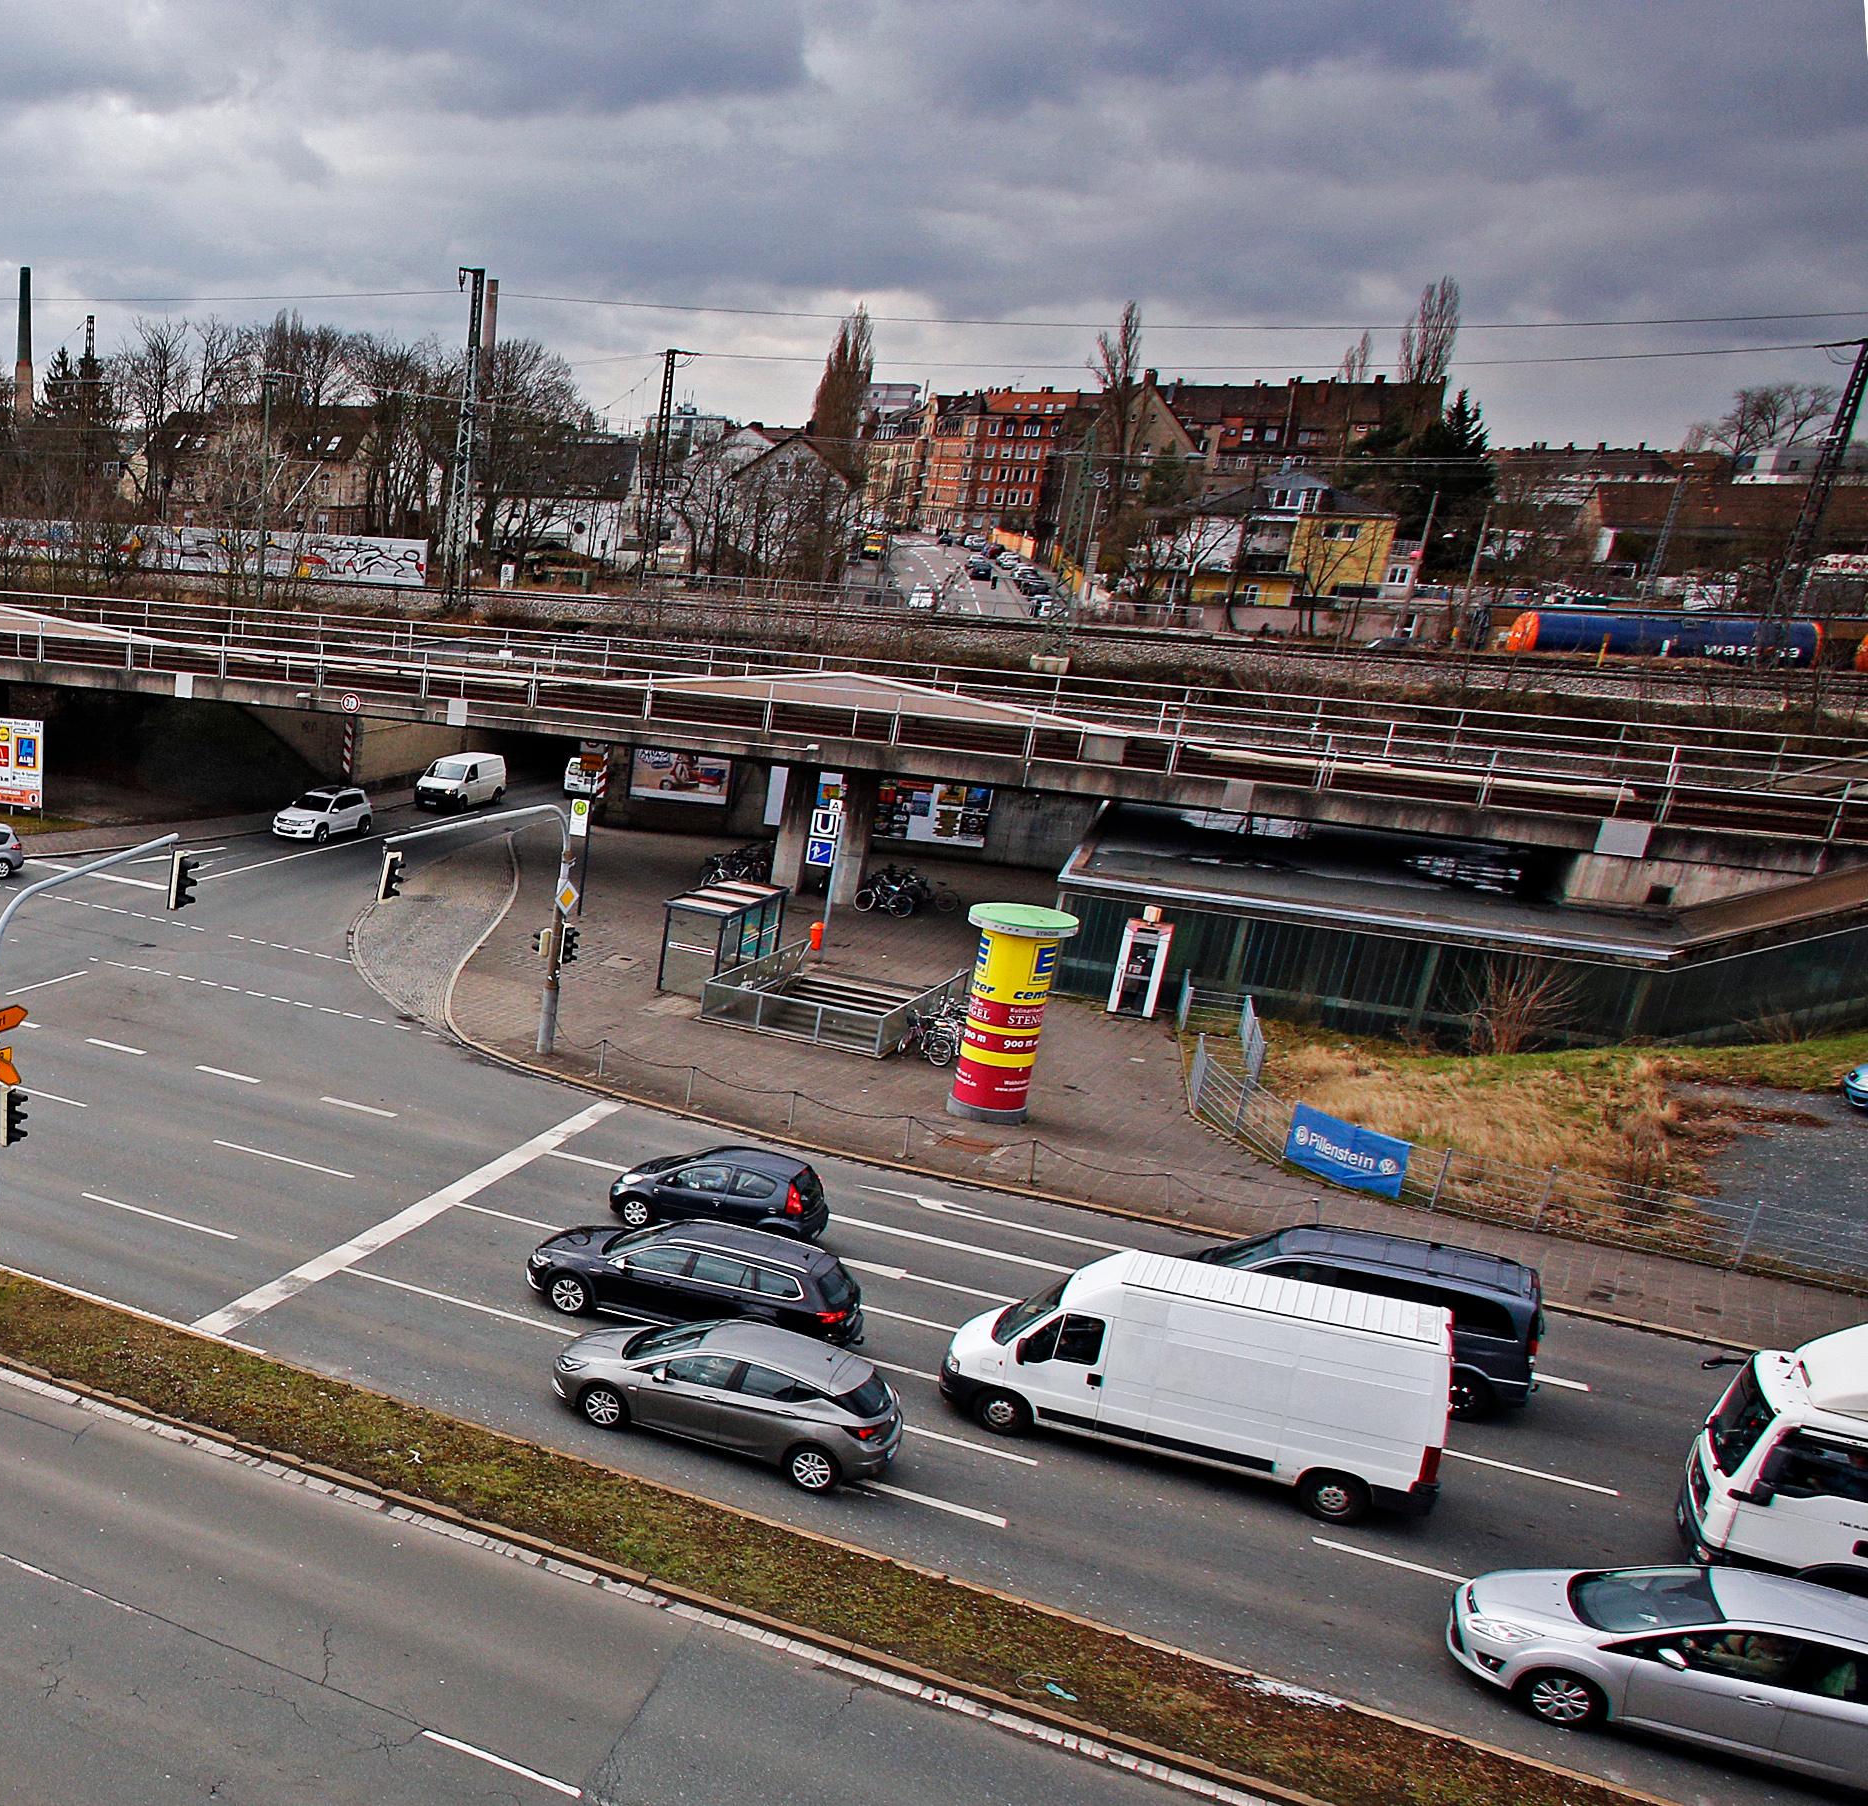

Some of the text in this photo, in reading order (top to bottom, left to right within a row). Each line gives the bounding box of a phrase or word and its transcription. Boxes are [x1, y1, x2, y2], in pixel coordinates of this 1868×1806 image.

[816, 813, 834, 833] U
[1003, 1040, 1024, 1049] 900
[1307, 1131, 1374, 1170] Pillenstein
